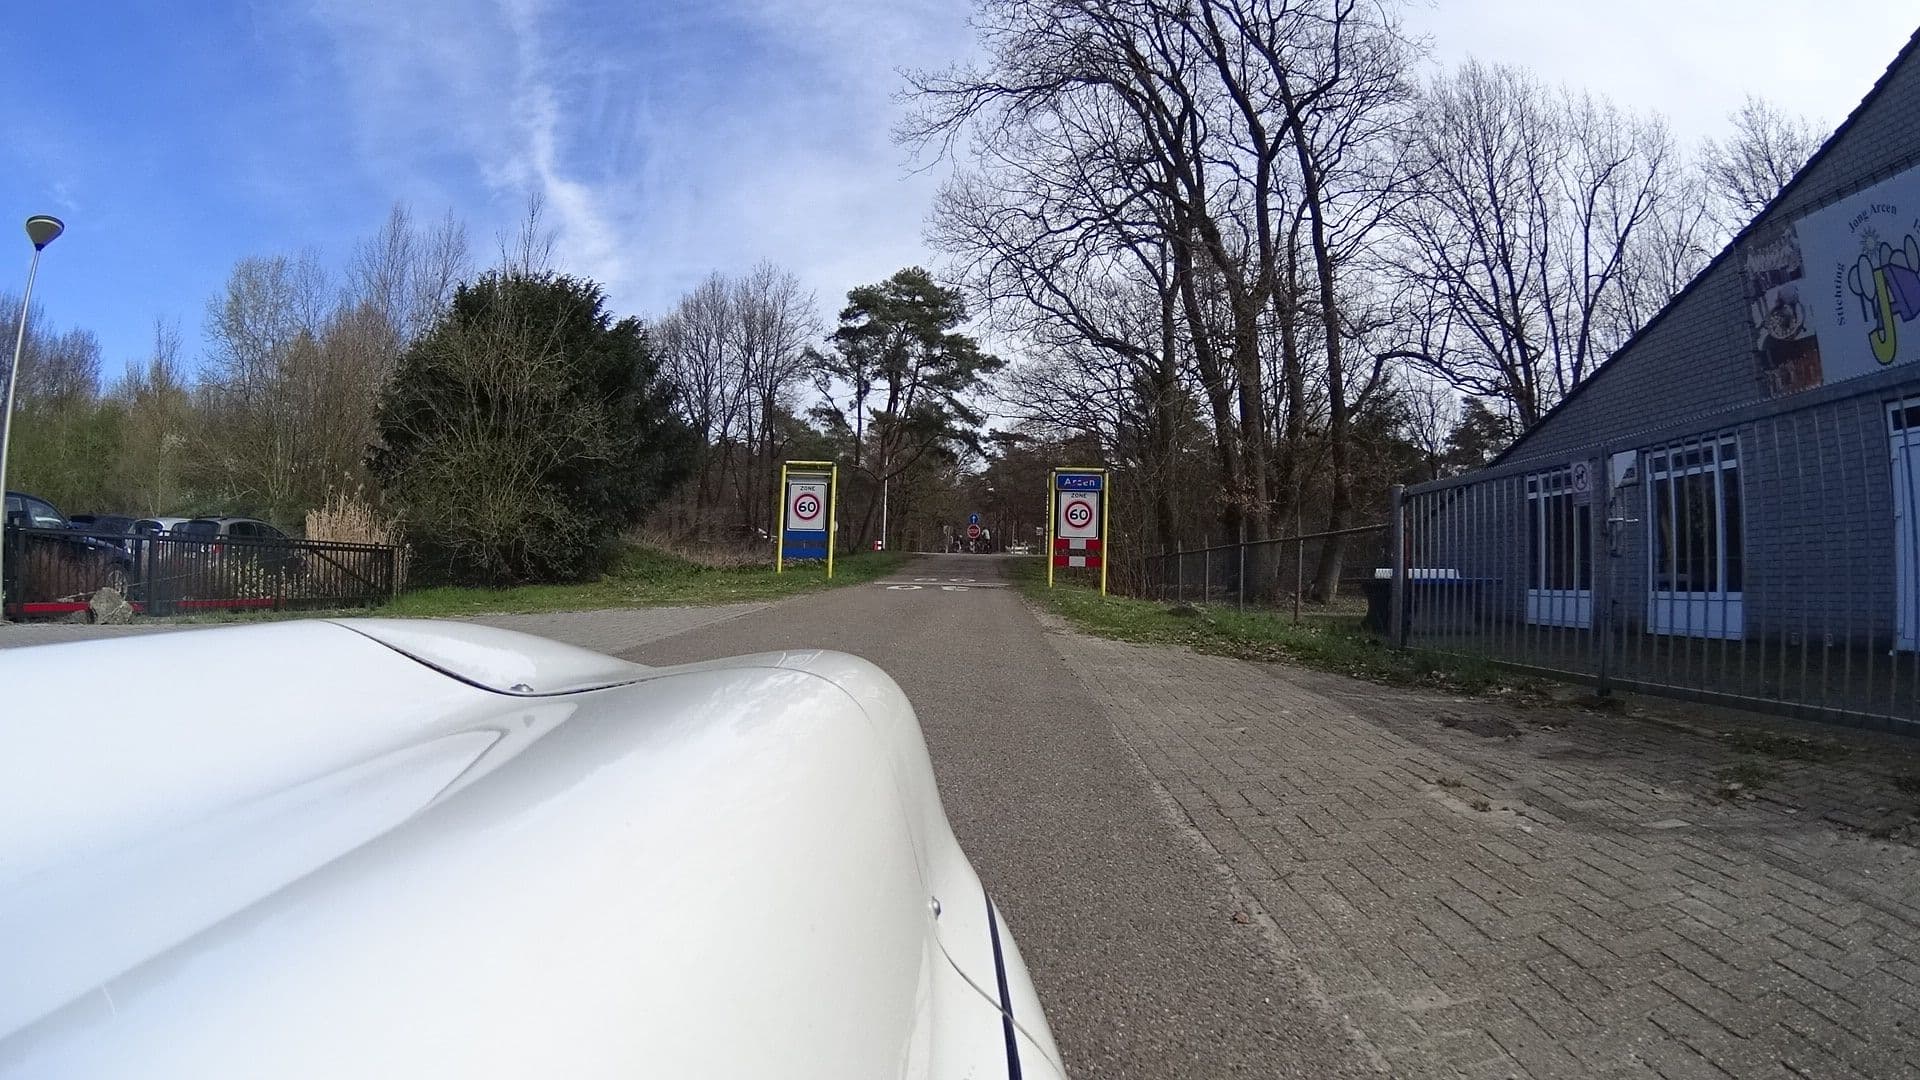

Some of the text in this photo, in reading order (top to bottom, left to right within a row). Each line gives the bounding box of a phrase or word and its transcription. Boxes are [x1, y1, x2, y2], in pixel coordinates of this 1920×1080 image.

[1848, 203, 1897, 234] Jong Arcen
[1833, 263, 1846, 327] Stichting
[1064, 477, 1095, 487] Arcen
[798, 501, 817, 513] 60
[1069, 508, 1089, 520] 60
